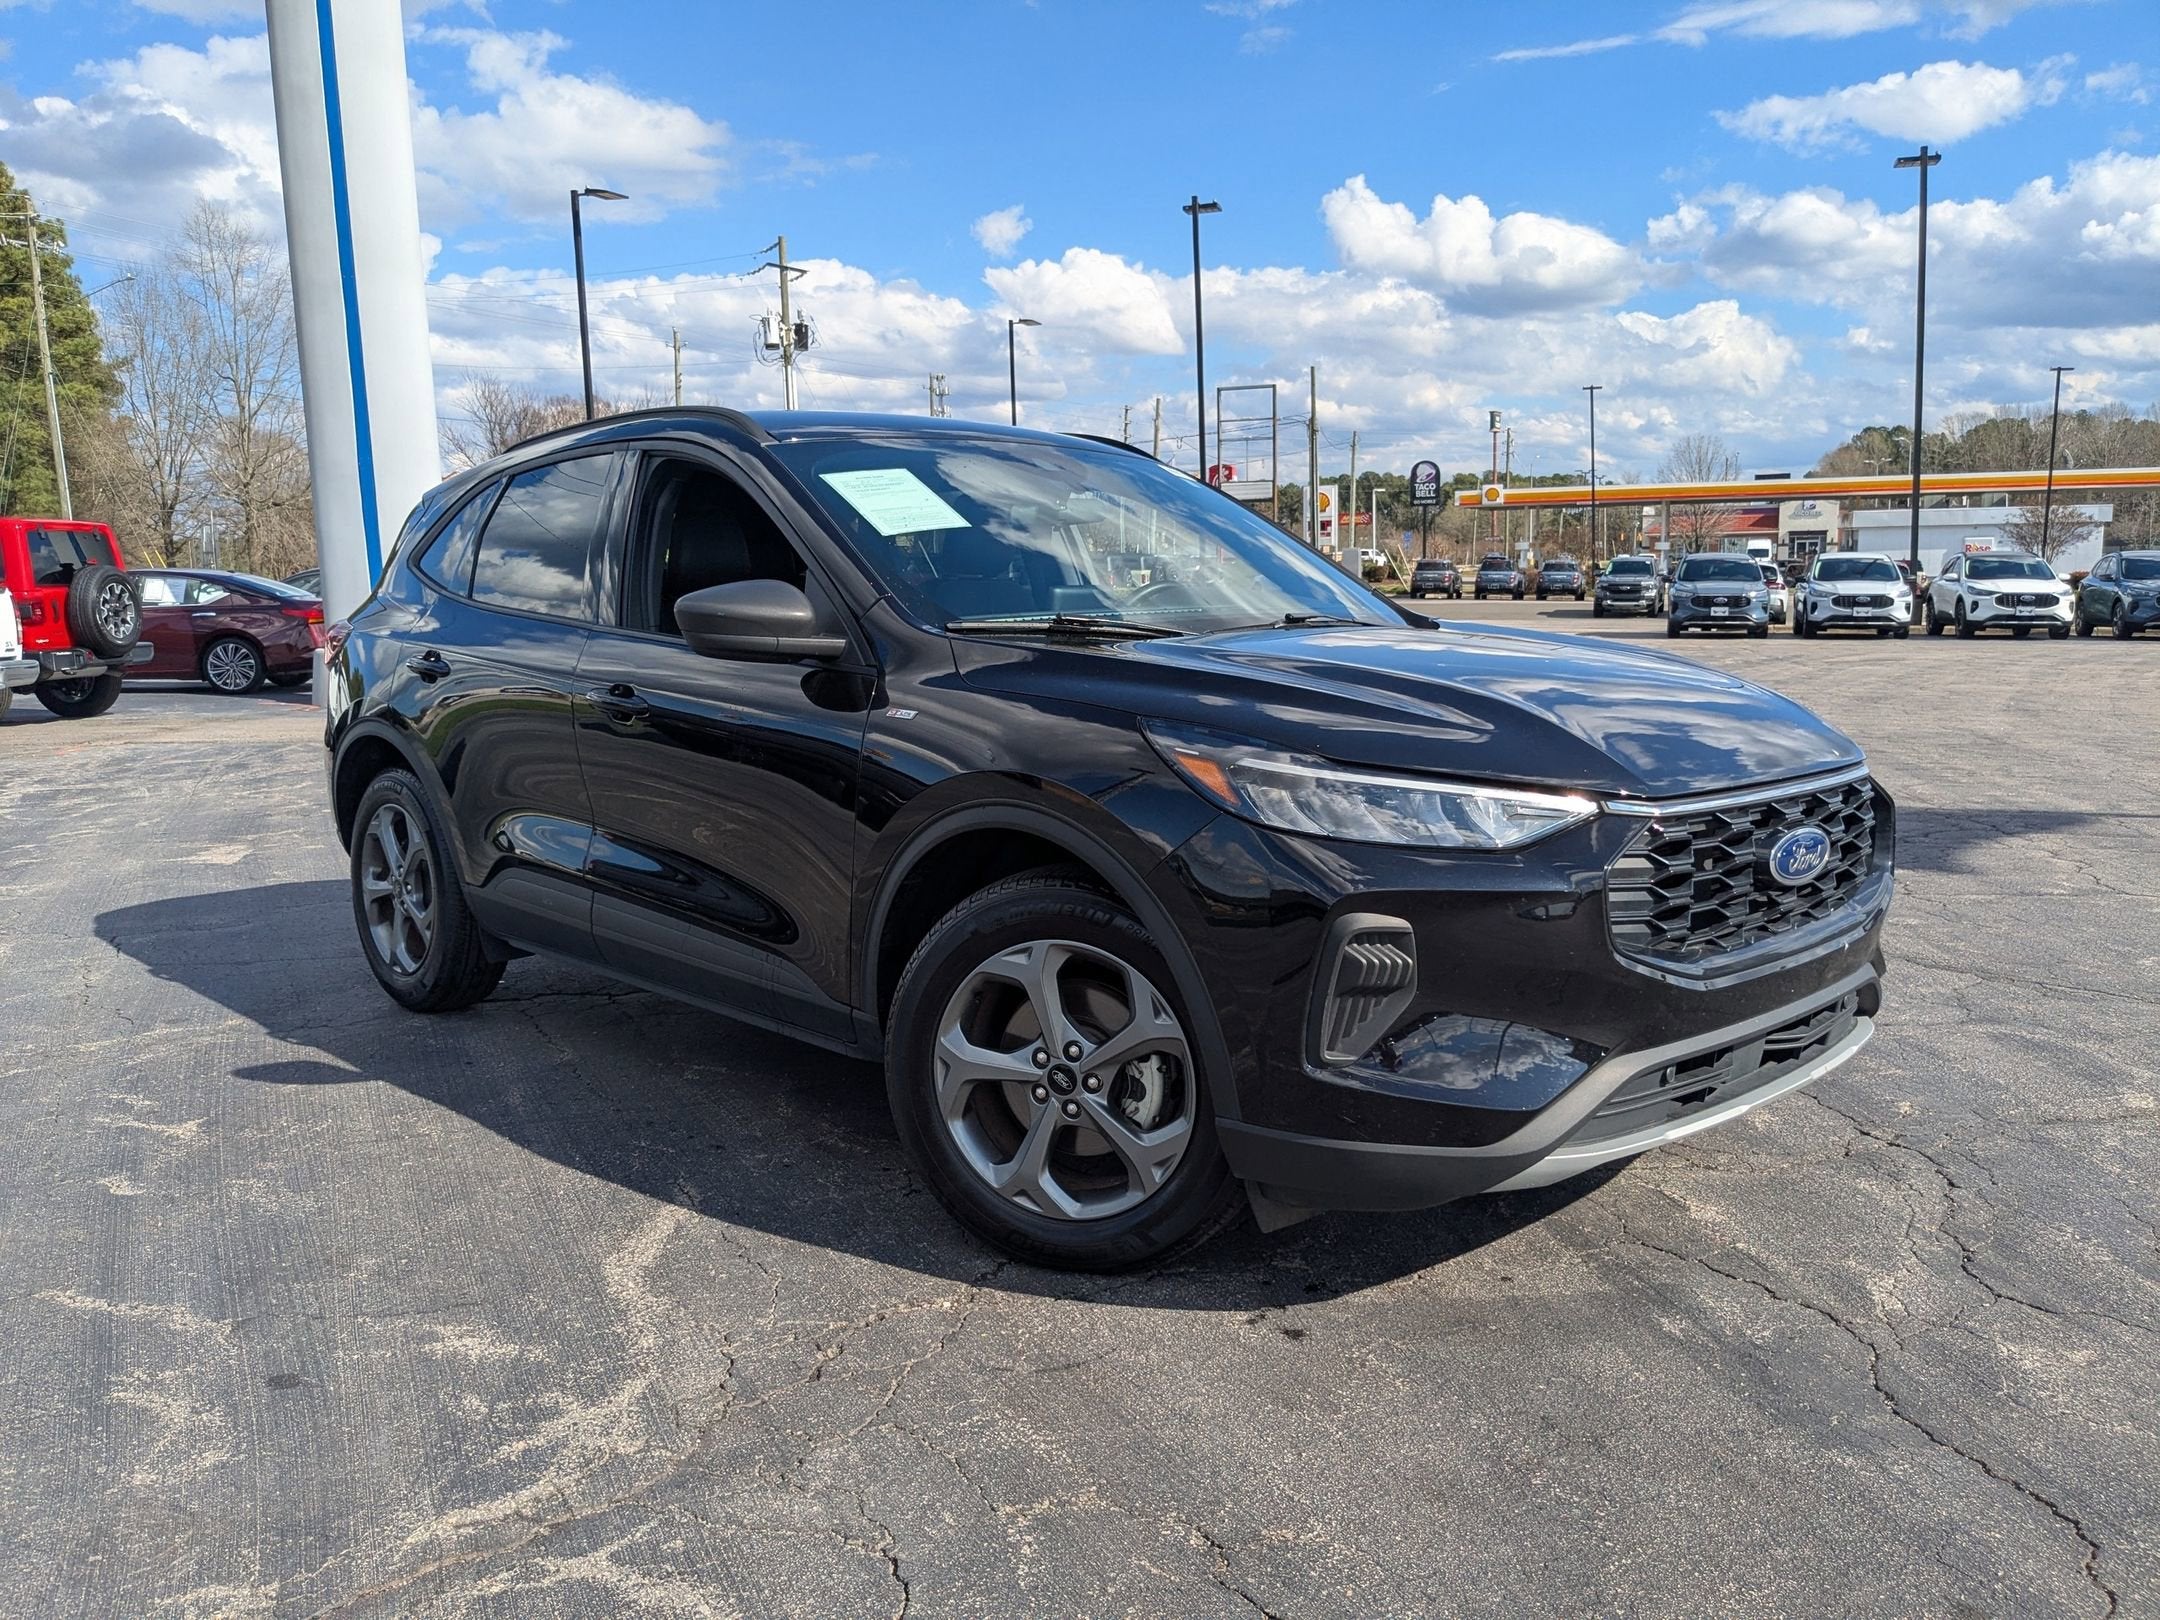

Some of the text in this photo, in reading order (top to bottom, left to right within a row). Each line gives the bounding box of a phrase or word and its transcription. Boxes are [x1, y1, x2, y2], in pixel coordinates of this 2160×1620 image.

[1415, 490, 1436, 498] BELL
[1788, 839, 1822, 874] Ford
[1008, 903, 1157, 949] MICHELIN PRIM
